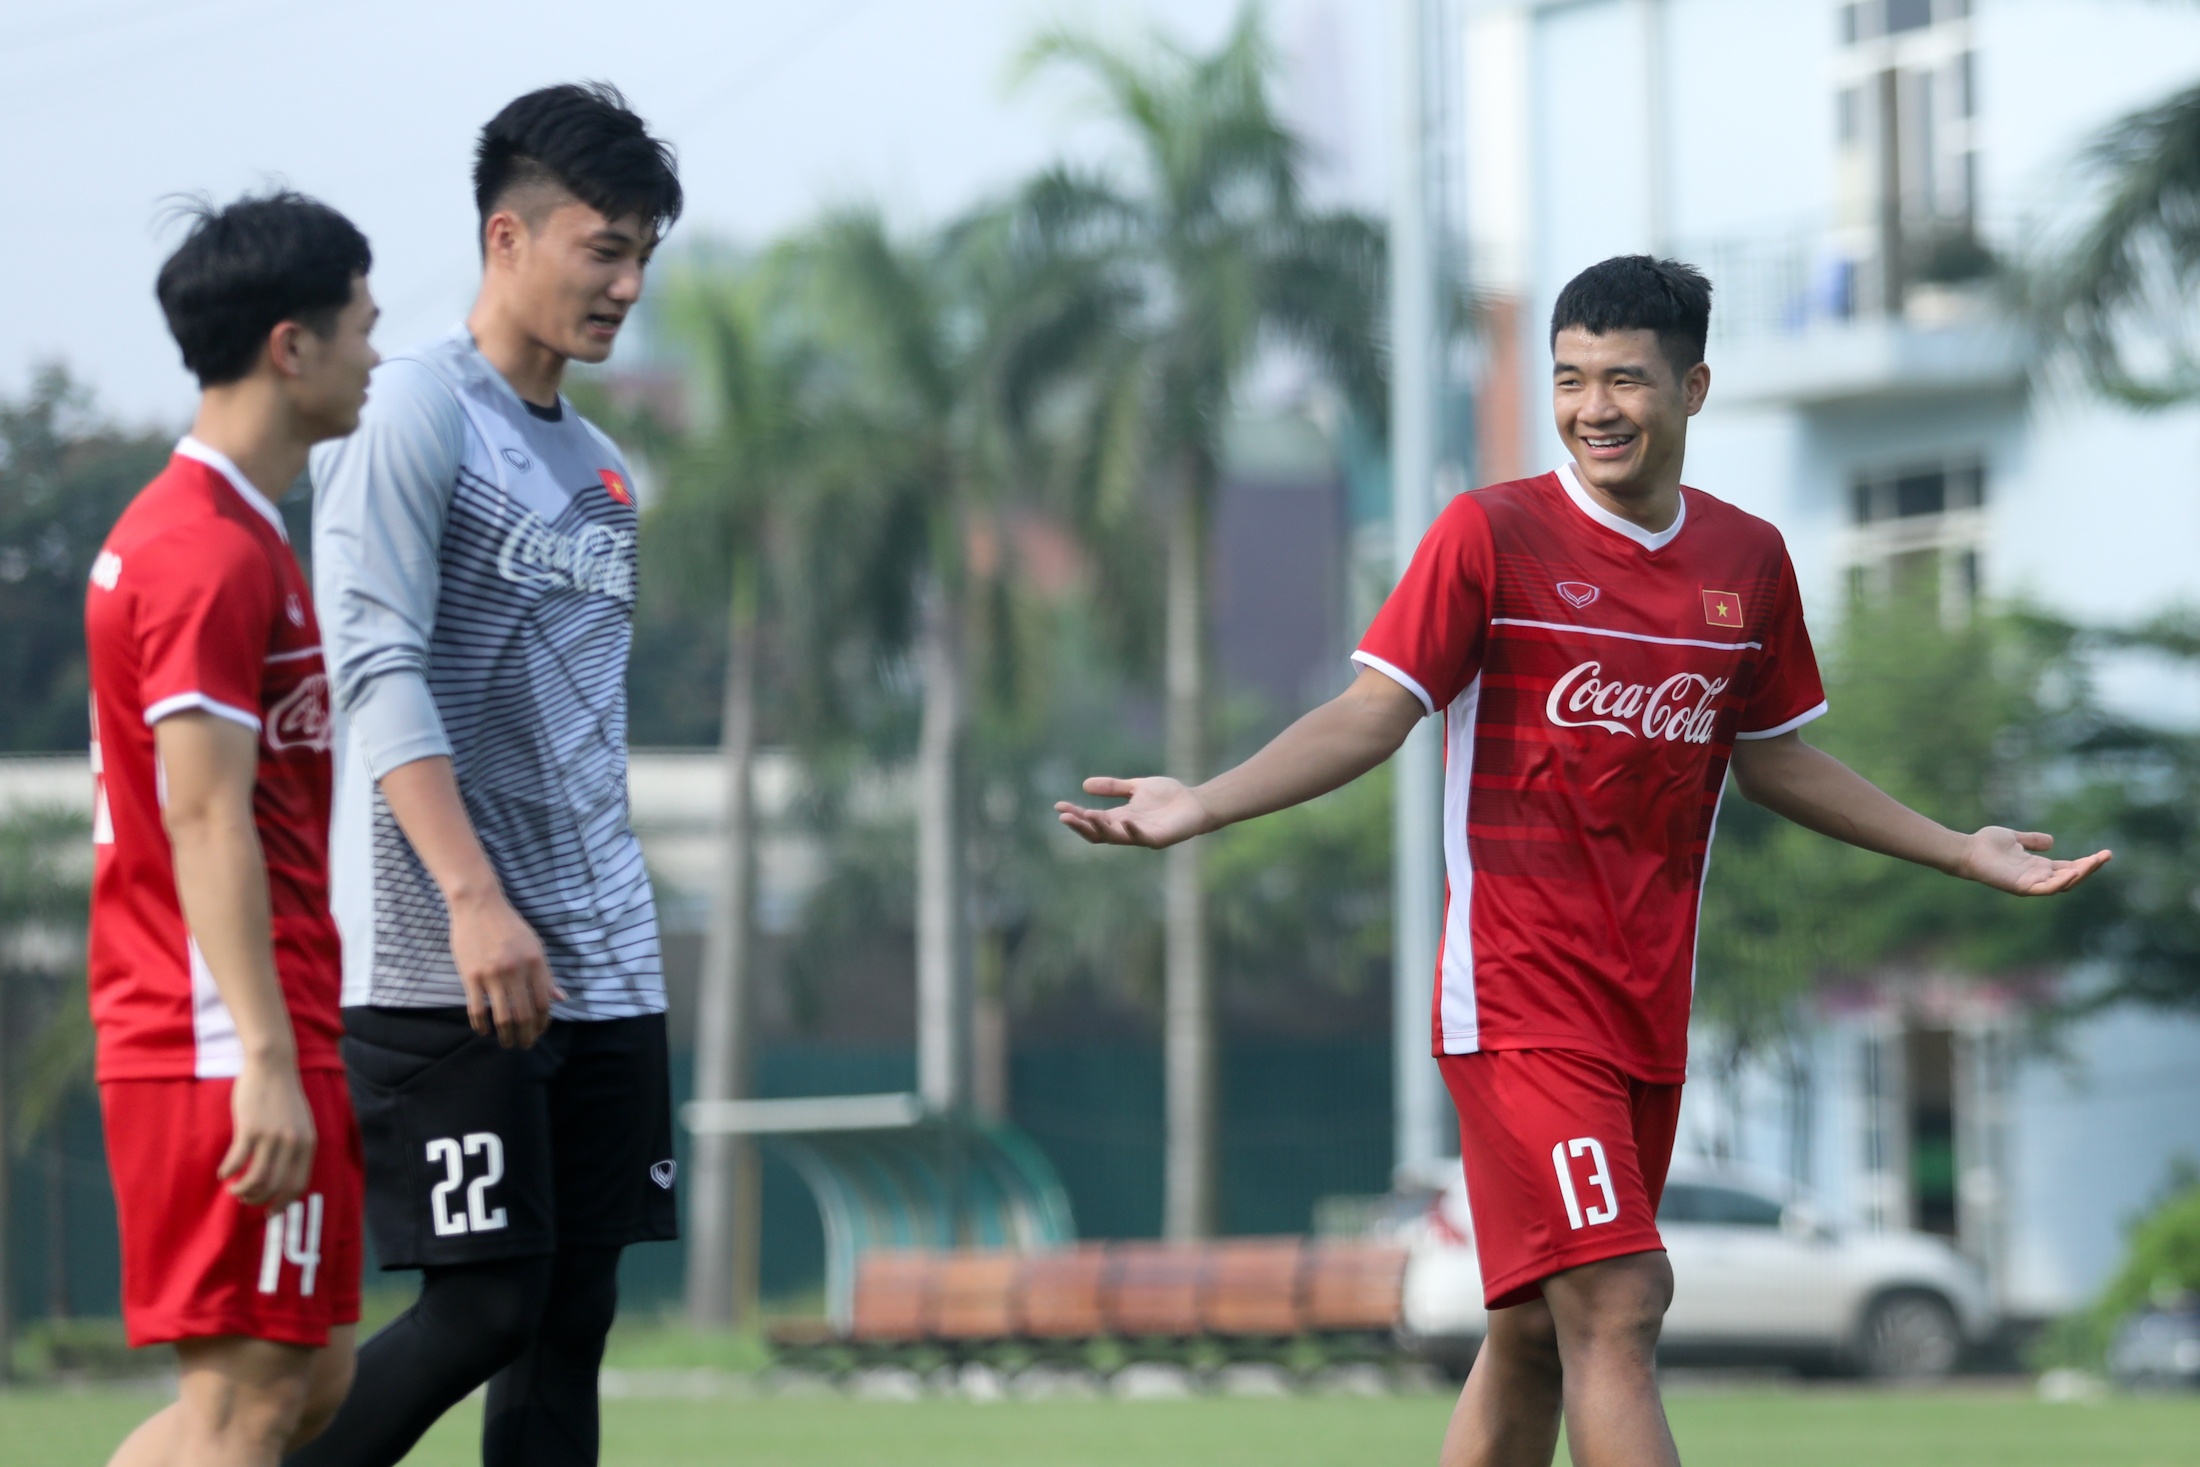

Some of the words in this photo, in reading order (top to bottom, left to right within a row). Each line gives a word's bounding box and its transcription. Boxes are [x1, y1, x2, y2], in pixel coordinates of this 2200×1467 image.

[426, 1131, 508, 1236] 22
[1551, 1137, 1618, 1230] 13
[258, 1192, 324, 1296] 14
